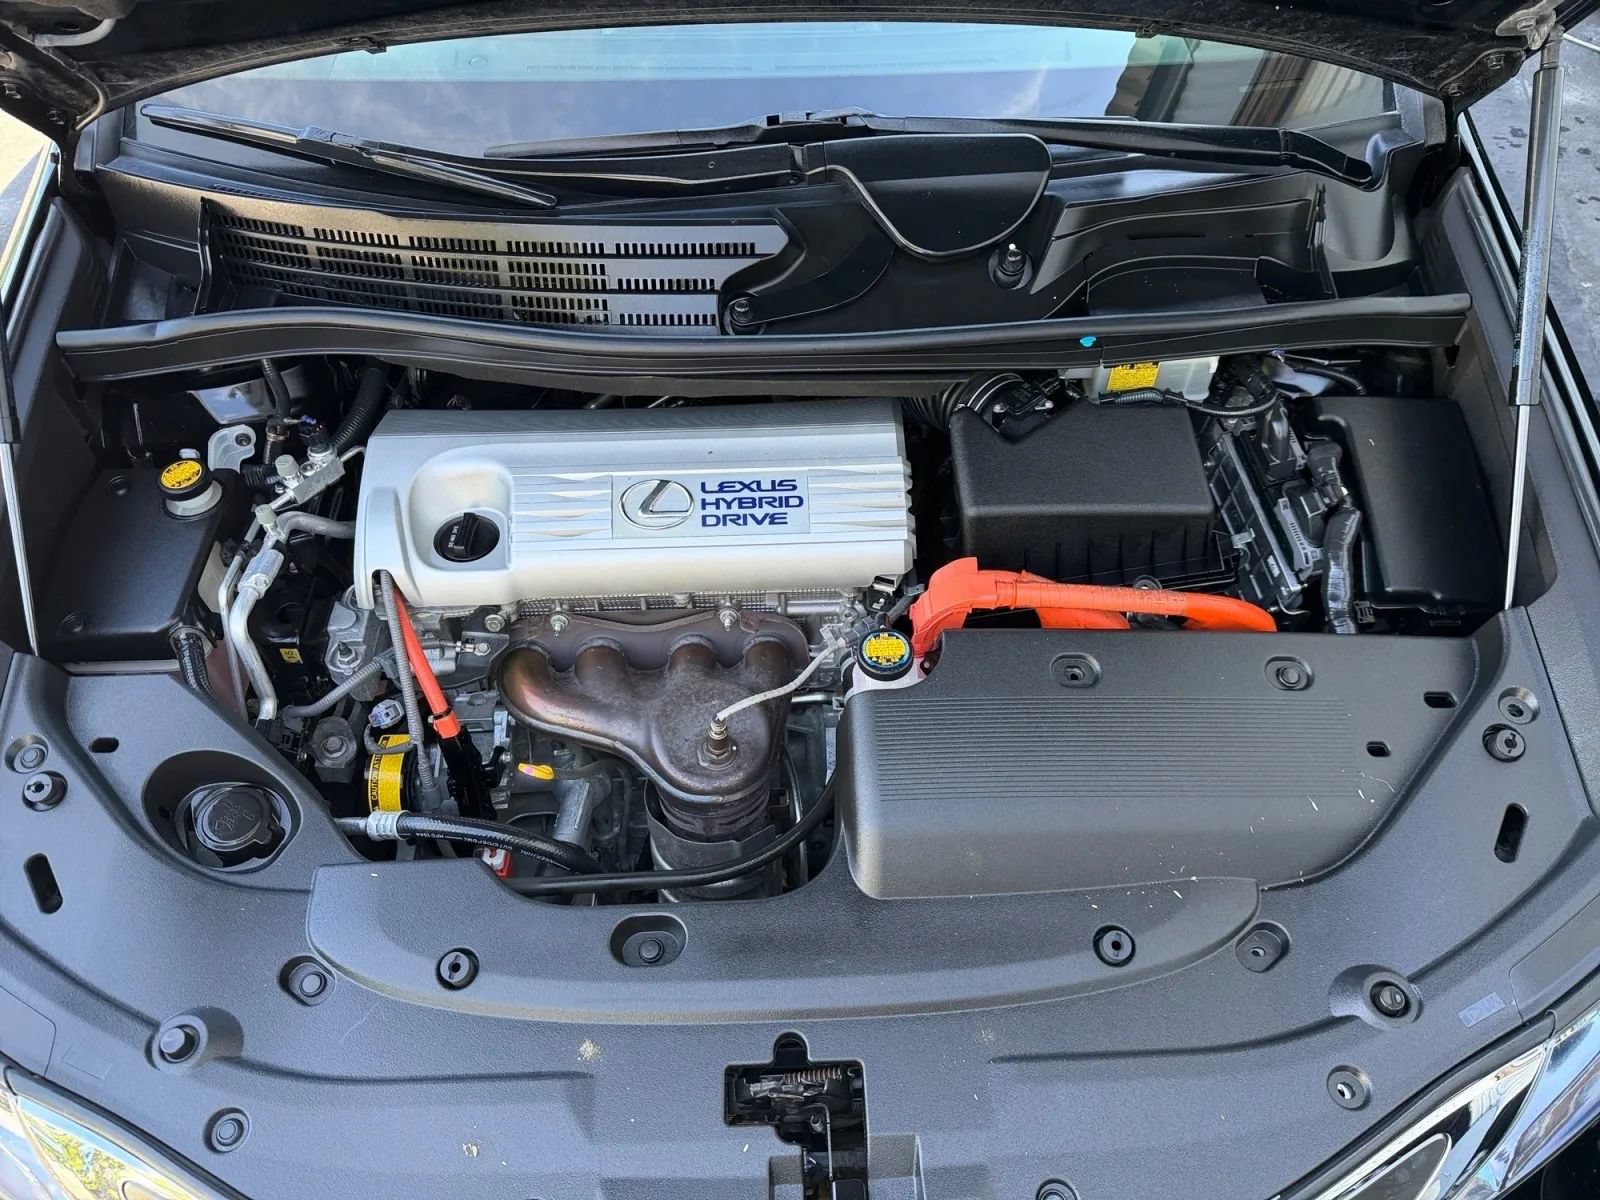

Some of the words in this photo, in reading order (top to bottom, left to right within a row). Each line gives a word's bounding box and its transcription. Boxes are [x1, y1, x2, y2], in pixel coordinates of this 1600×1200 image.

[701, 479, 797, 494] LEXUS
[701, 495, 804, 510] HYBRID
[701, 512, 788, 527] DRIVE
[371, 771, 379, 801] CAUTION
